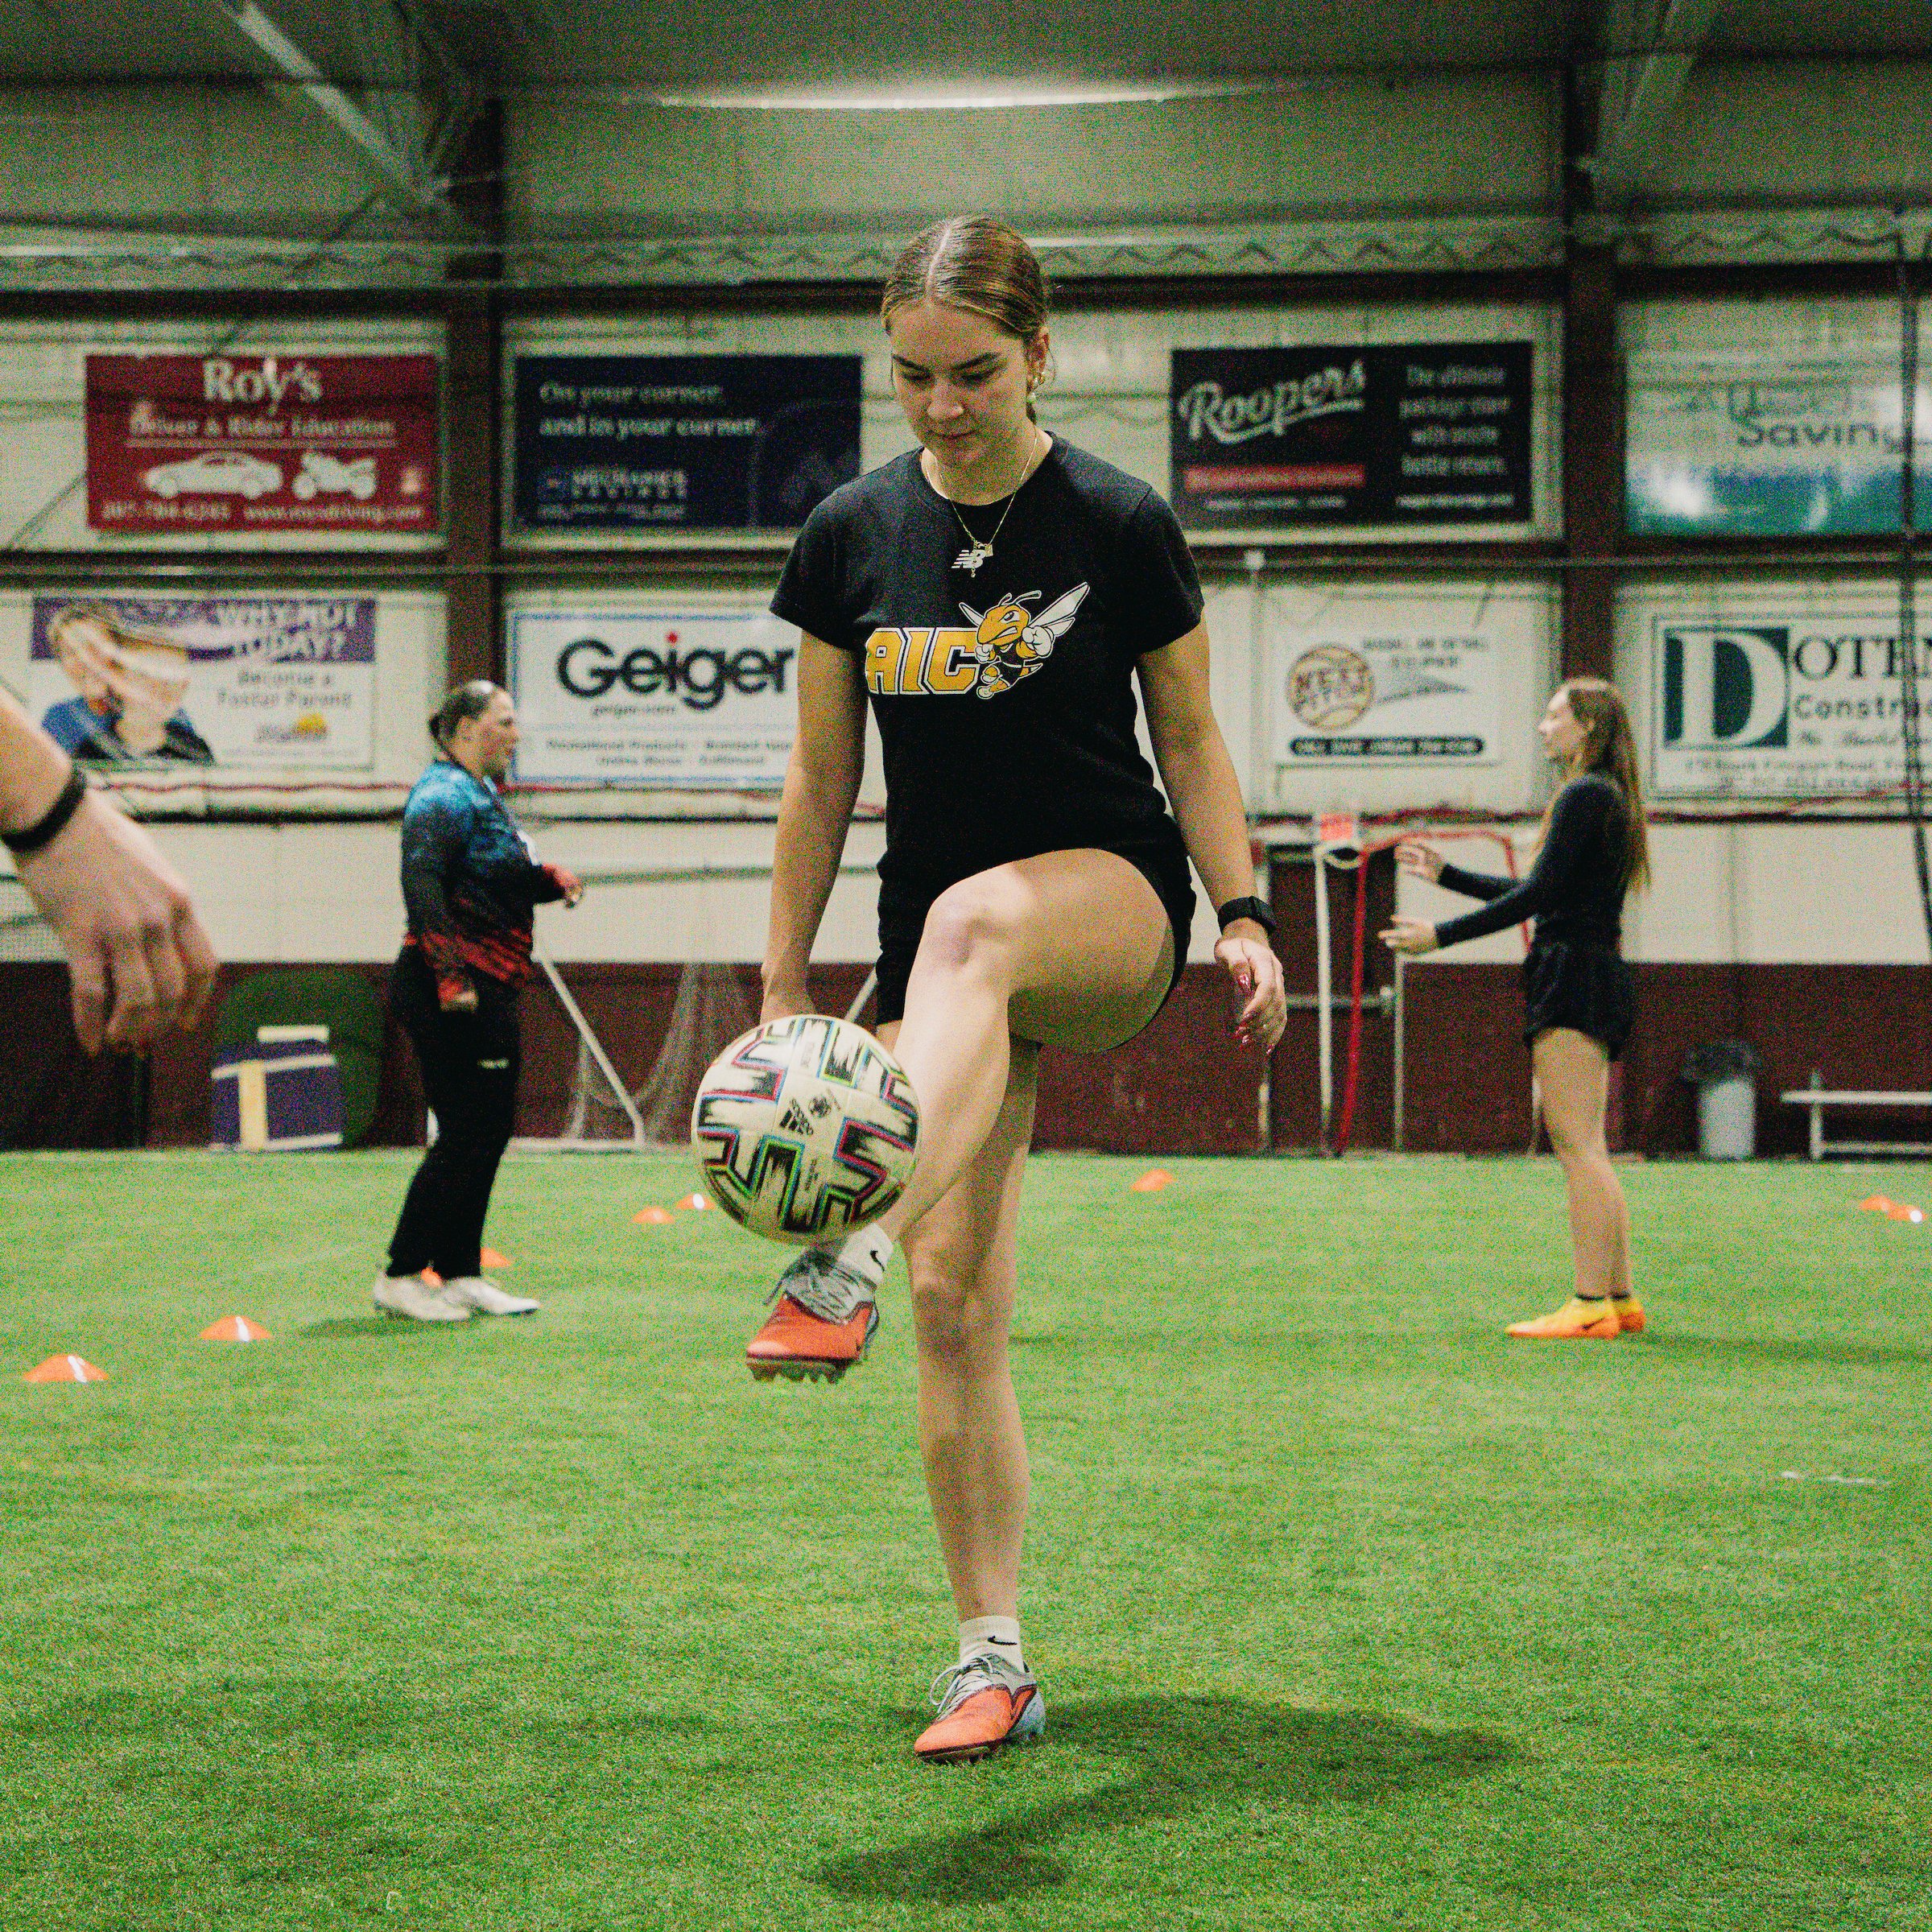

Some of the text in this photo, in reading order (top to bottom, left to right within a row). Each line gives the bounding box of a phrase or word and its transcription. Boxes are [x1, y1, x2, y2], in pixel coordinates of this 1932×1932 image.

[203, 359, 323, 415] Roy's
[1178, 357, 1367, 444] Roopers
[556, 630, 796, 712] Geiger
[865, 627, 980, 695] AIC
